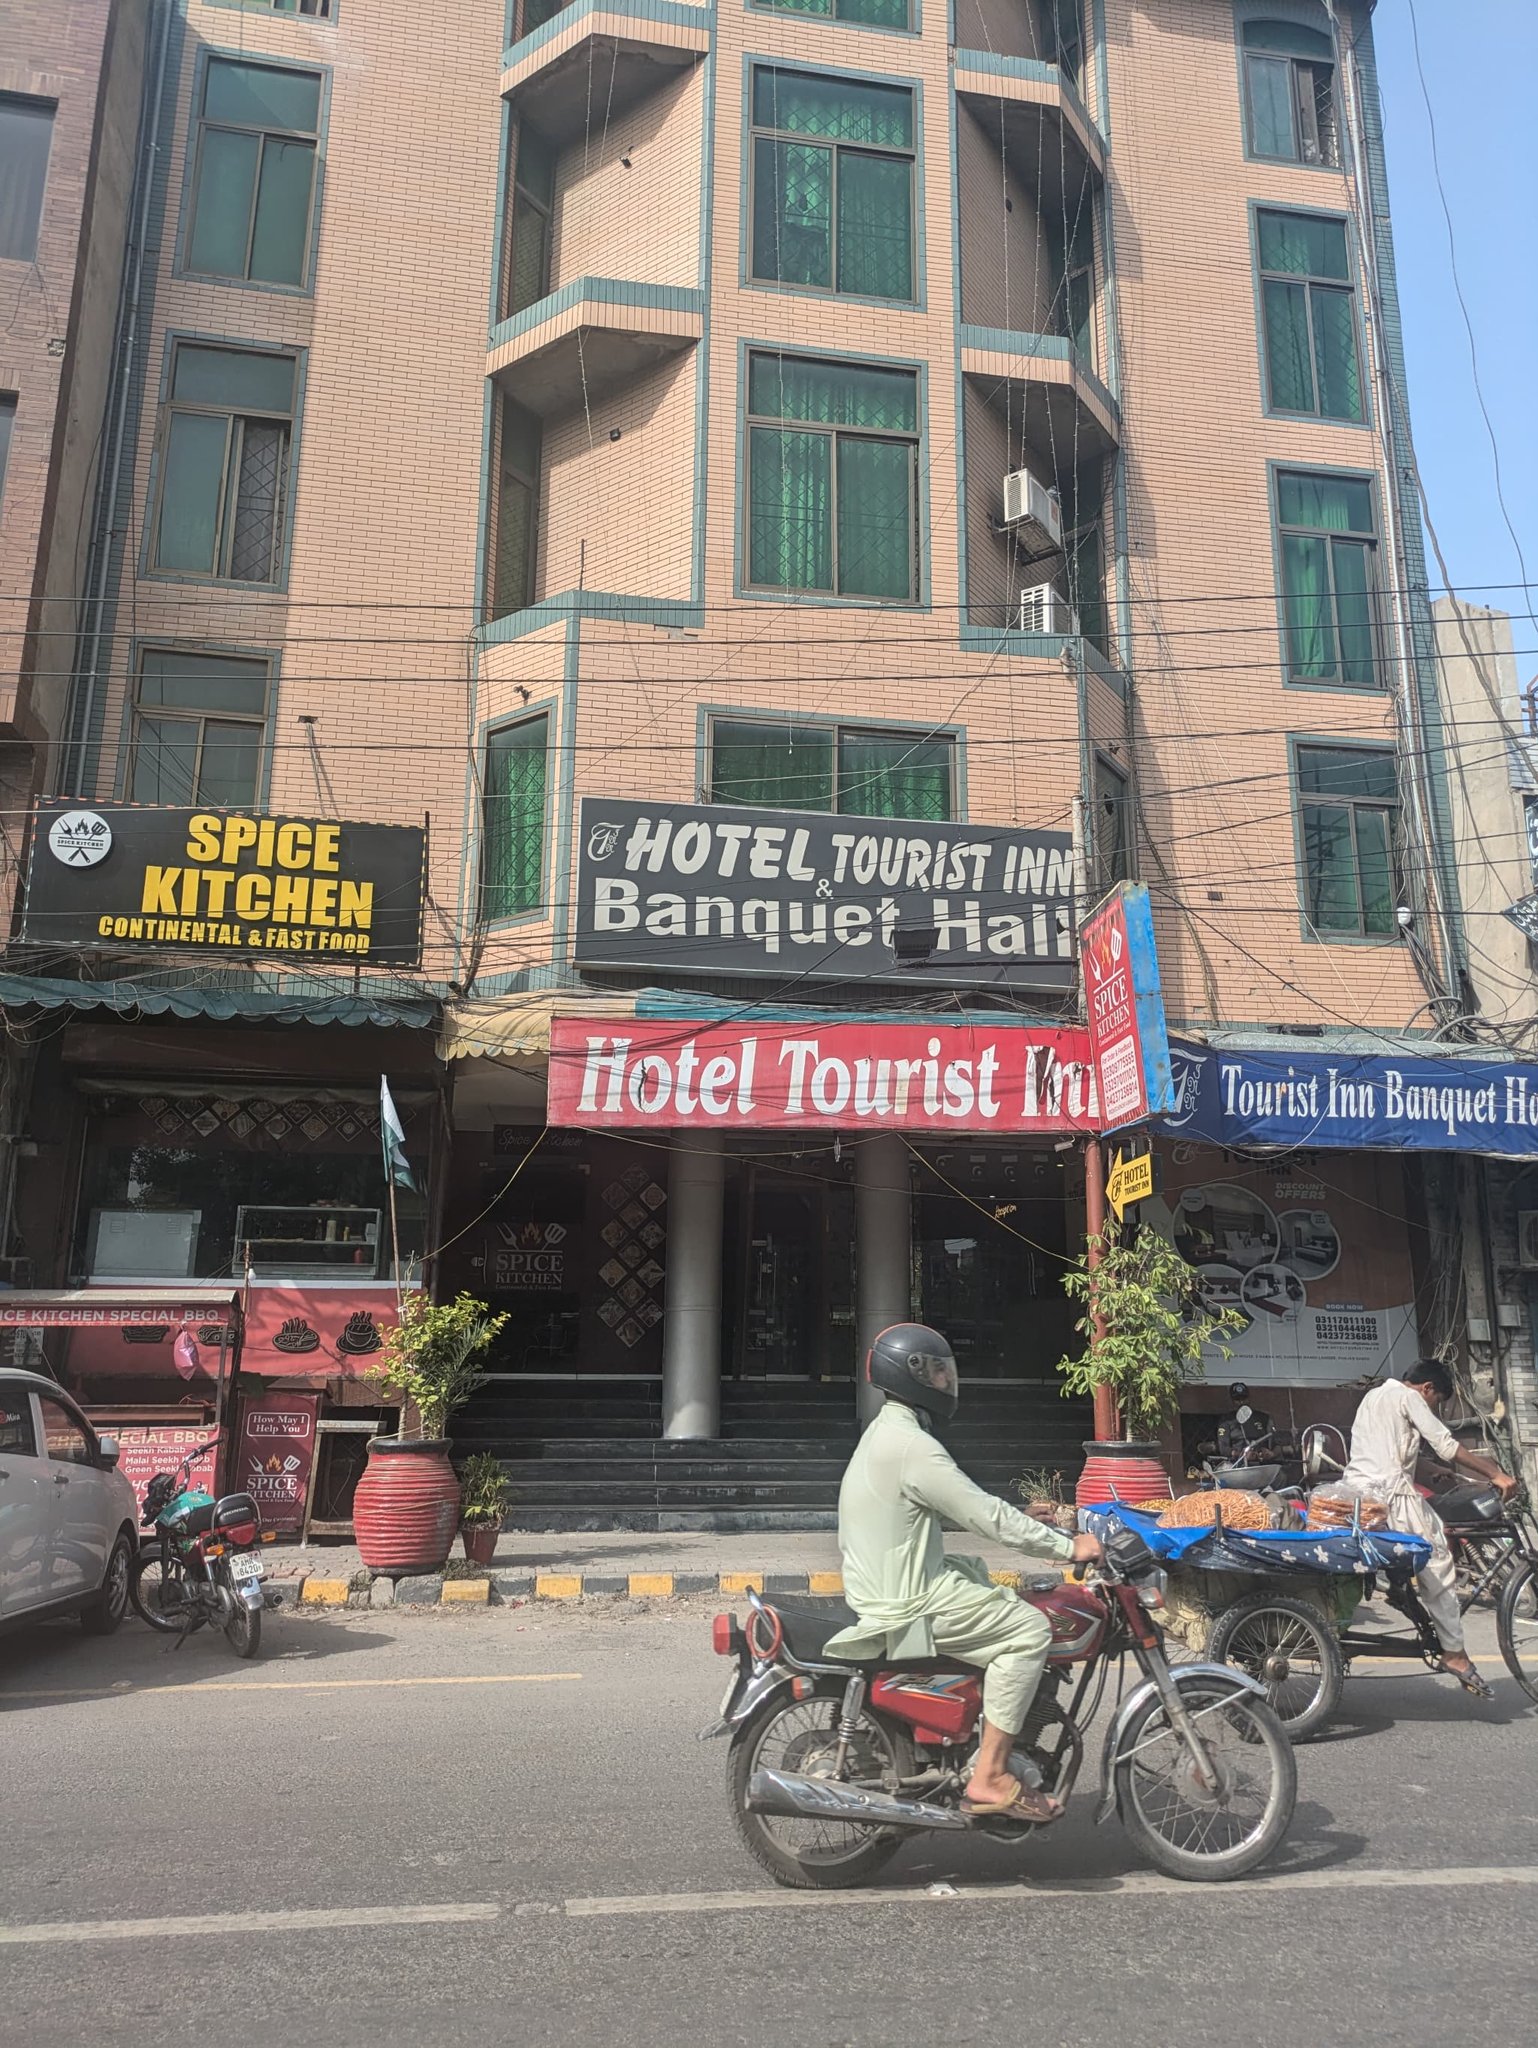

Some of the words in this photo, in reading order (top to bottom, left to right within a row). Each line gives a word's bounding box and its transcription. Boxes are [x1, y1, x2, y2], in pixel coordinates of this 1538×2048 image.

[186, 813, 341, 872] SPICE
[624, 817, 817, 883] HOTEL
[831, 833, 991, 894] TOURIST
[1003, 844, 1075, 898] INN
[815, 878, 835, 900] &
[140, 865, 374, 929] KITCHEN
[593, 877, 900, 954] Banquet
[932, 898, 1072, 958] Hall
[98, 915, 242, 946] CONTINENTAL
[248, 929, 262, 947] &
[266, 928, 317, 951] FAST
[318, 931, 371, 954] FOOD
[1094, 975, 1129, 1020] SPICE
[1096, 1002, 1131, 1039] KITCHEN
[576, 1035, 758, 1114] Hotel
[778, 1037, 1000, 1120] Tourist
[1221, 1064, 1319, 1118] Tourist
[1326, 1068, 1375, 1119] Inn
[1384, 1070, 1497, 1136] Banquet
[1124, 1163, 1149, 1185] HOTEL
[1125, 1182, 1141, 1196] TOURIST
[1142, 1180, 1150, 1190] INN
[1275, 1183, 1326, 1191] DISCOUNT
[1275, 1190, 1326, 1200] OFFERS
[495, 1253, 565, 1272] SPICE
[495, 1272, 563, 1284] KITCHEN
[32, 1309, 105, 1321] KITCHEN
[110, 1309, 179, 1322] SPECIAL
[184, 1310, 219, 1322] BBQ
[1315, 1316, 1377, 1325] 03117011100
[1316, 1324, 1377, 1333] 03210444922
[253, 1415, 275, 1424] How
[278, 1416, 299, 1426] May
[301, 1416, 305, 1424] I
[255, 1425, 279, 1434] Help
[282, 1425, 300, 1433] You
[173, 1431, 209, 1444] BBQ
[152, 1456, 179, 1464] Seekh
[125, 1465, 152, 1473] Green
[246, 1477, 298, 1490] SPICE
[246, 1490, 297, 1499] KITCHEN
[239, 1564, 259, 1577] 8420
